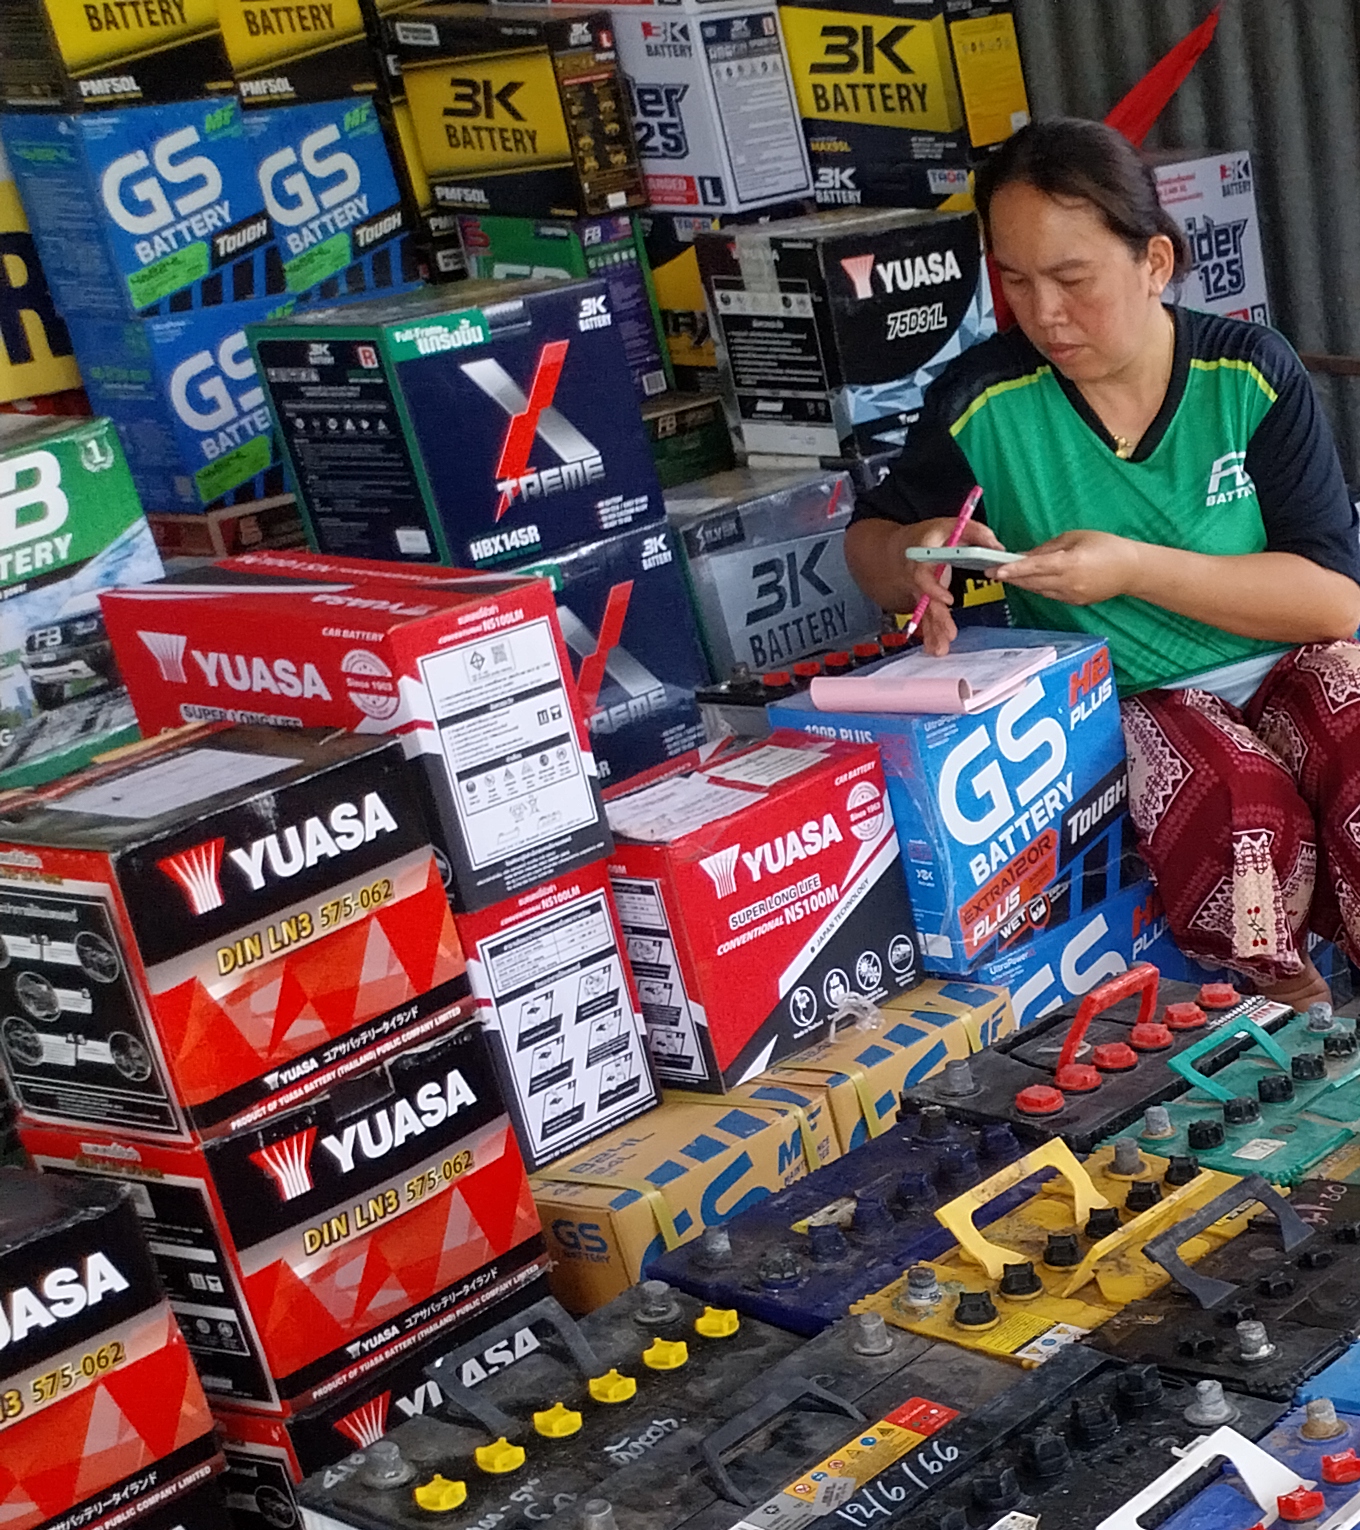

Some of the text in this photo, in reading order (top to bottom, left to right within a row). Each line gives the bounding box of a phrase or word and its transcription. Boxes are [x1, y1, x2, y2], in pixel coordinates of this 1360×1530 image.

[84, 0, 188, 32] BATTERY
[243, 3, 335, 37] BATTERY
[645, 44, 694, 59] BATTERY
[808, 25, 916, 75] 3K
[442, 78, 527, 123] 3K
[811, 82, 928, 114] BATTERY
[445, 123, 538, 154] BATTERY
[103, 125, 222, 234] GS
[258, 124, 360, 227] GS
[814, 167, 857, 189] 3K
[815, 188, 862, 205] BATTERY
[1222, 181, 1251, 197] BATTERY
[135, 200, 232, 264] BATTERY
[215, 218, 268, 257] TOUGH
[287, 195, 370, 255] BATTERY
[355, 211, 402, 248] TOUGH
[876, 250, 961, 294] YUASA
[1200, 258, 1246, 303] 125
[579, 295, 606, 318] 3K
[579, 312, 612, 332] BATTERY
[886, 302, 947, 341] 75D31L
[200, 406, 271, 461] BATTE
[0, 533, 73, 581] TERY
[641, 534, 667, 558] 3K
[641, 550, 672, 571] BATTERY
[745, 538, 835, 628] 3K
[342, 628, 385, 643] BATTERY
[749, 600, 849, 670] BATTERY
[191, 650, 332, 701] YUASA
[1069, 646, 1110, 707] HB
[1070, 677, 1112, 731] PLUS
[848, 761, 877, 781] BATTERY
[939, 676, 1067, 846] GS
[969, 773, 1074, 886] BATTERY
[1067, 774, 1128, 844] TOUGH
[230, 792, 398, 891] YUASA
[742, 813, 843, 882] YUASA
[717, 884, 840, 956] CONVENTIONAL NS100M
[730, 874, 821, 929] SUPER LONG LIFE
[973, 886, 1021, 947] PLUS
[1000, 907, 1026, 939] WET
[217, 879, 393, 975] DIN LN3 575-062
[279, 1058, 319, 1086] YUASA
[321, 1069, 477, 1173] YUASA
[303, 1150, 473, 1256] DIN LN3 575-062
[552, 1219, 608, 1253] GS
[0, 1251, 130, 1352] ASA
[361, 1324, 401, 1352] YUASA
[32, 1341, 126, 1404] 575-062
